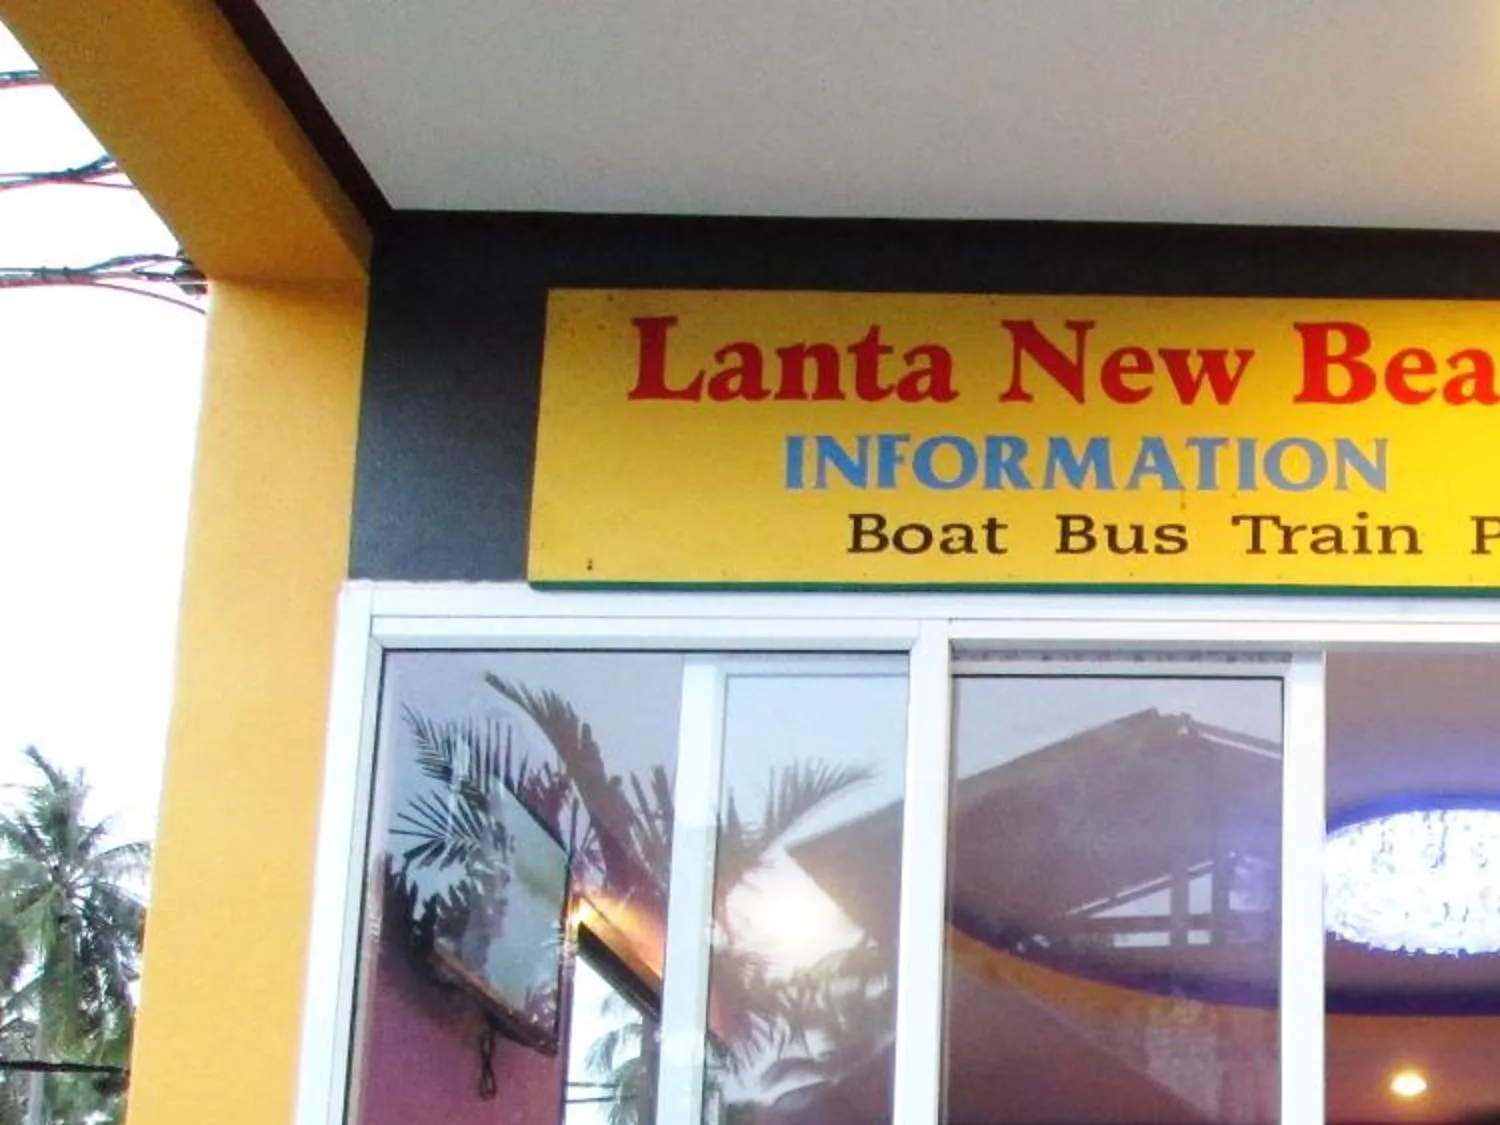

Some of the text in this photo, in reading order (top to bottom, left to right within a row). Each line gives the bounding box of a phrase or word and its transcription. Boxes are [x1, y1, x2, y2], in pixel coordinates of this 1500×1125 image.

[626, 315, 960, 405] Lanta
[999, 316, 1255, 407] New
[781, 433, 1390, 494] INFORMATION
[845, 511, 1007, 556] Boat
[1054, 513, 1188, 556] Bus
[1230, 513, 1423, 557] Train
